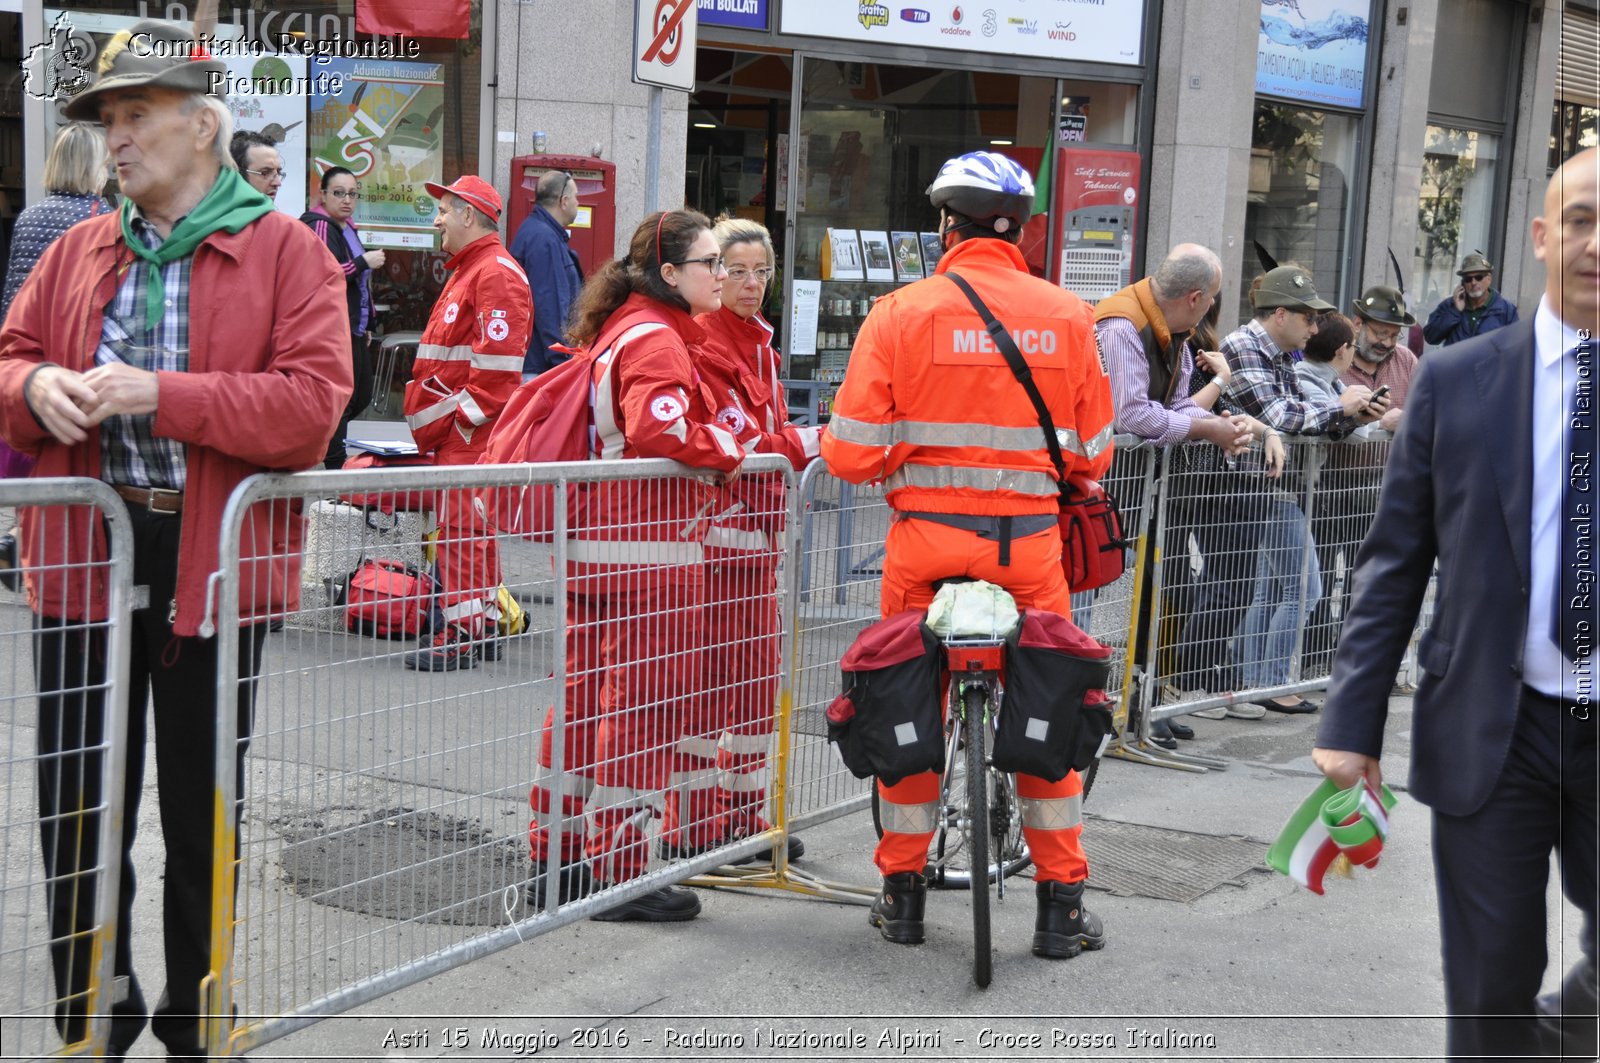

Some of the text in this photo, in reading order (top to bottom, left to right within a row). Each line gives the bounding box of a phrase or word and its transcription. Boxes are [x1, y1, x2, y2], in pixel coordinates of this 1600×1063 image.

[717, 0, 759, 14] BOLLATI
[859, 4, 885, 16] Gratta
[913, 11, 928, 21] TIM
[940, 27, 971, 37] vodafone
[1047, 30, 1076, 41] WIND
[353, 64, 390, 77] Adunata
[393, 66, 437, 81] Nazionale
[541, 157, 588, 168] POSTE
[1074, 167, 1131, 178] Self Service
[375, 184, 388, 192] 14
[400, 184, 413, 193] 15
[1084, 180, 1122, 190] Tabacchi
[357, 192, 413, 204] aggio 2016
[953, 329, 1056, 355] MEICO
